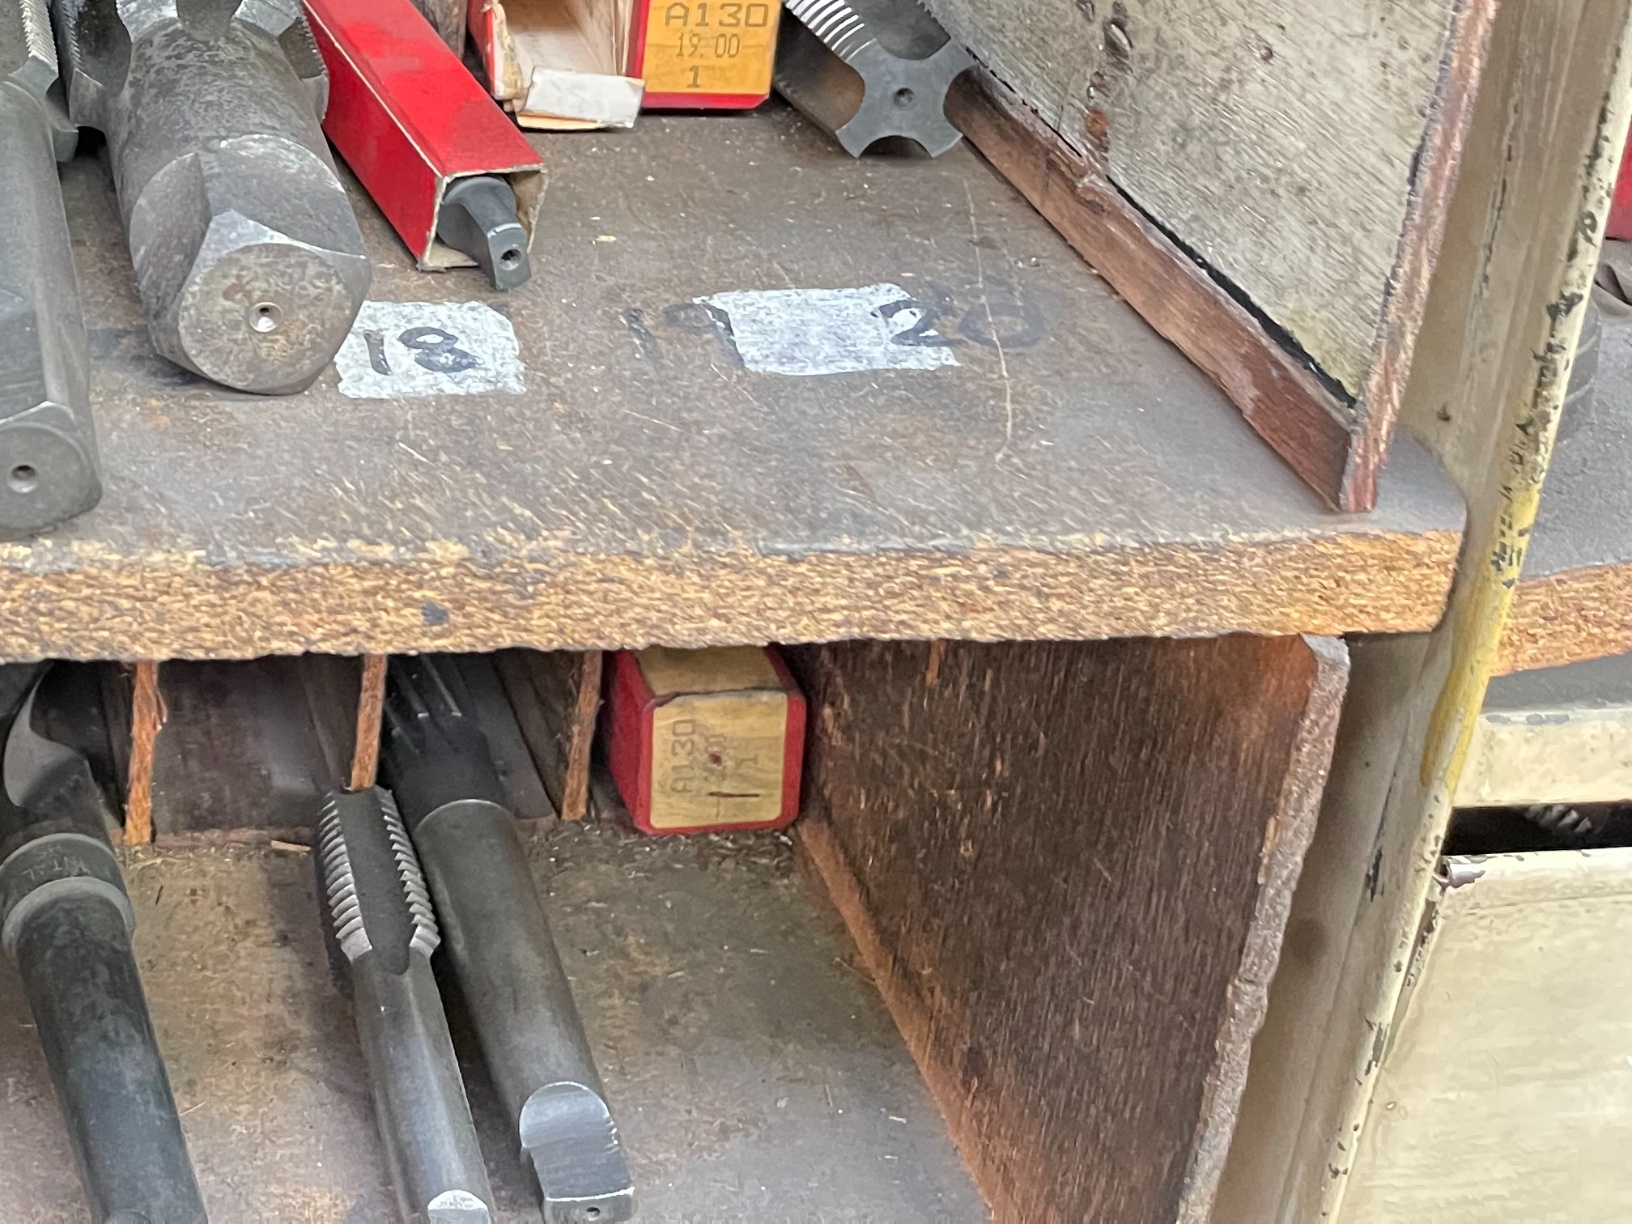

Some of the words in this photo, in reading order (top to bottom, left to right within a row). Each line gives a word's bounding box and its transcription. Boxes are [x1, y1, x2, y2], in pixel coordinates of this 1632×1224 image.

[665, 2, 769, 27] A130
[676, 33, 740, 58] 19.00
[686, 65, 701, 88] 1
[362, 326, 481, 377] 18
